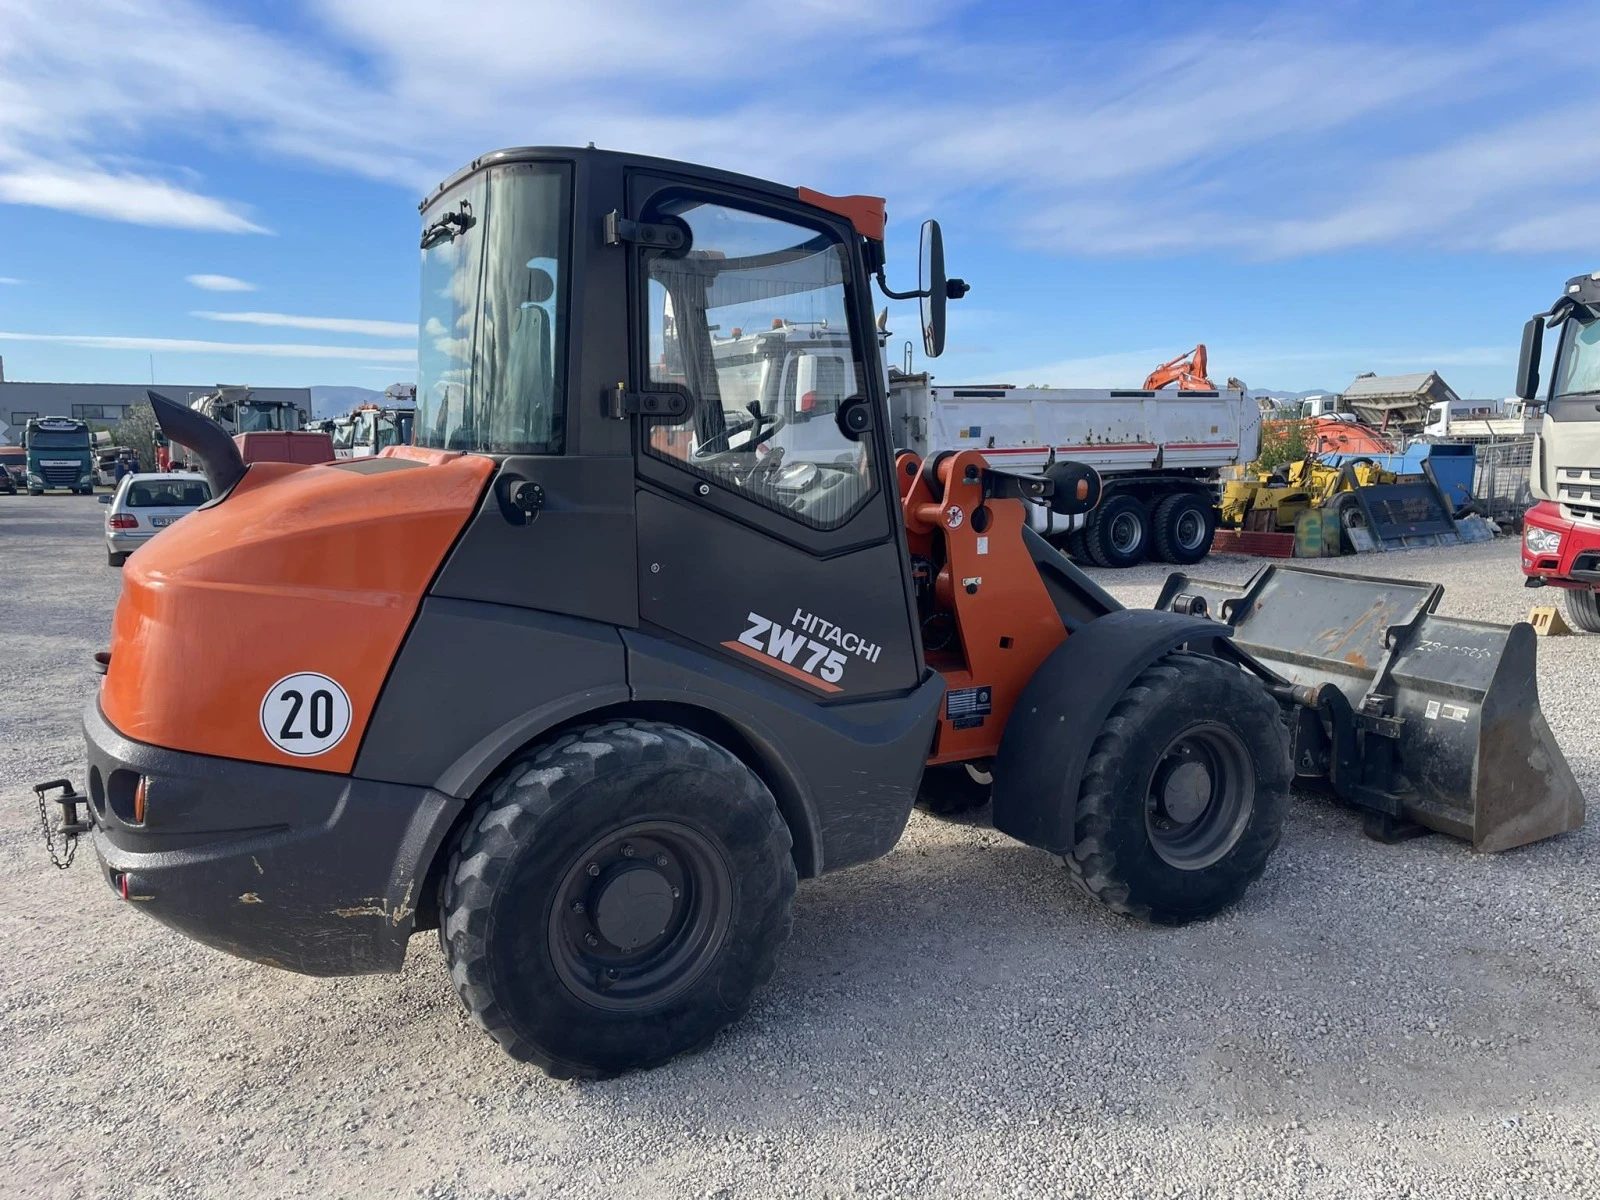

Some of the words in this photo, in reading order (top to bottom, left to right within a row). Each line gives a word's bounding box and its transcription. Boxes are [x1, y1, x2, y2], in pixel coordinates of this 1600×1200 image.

[737, 611, 849, 684] ZW75
[791, 608, 883, 664] HITACHI
[280, 689, 334, 740] 20
